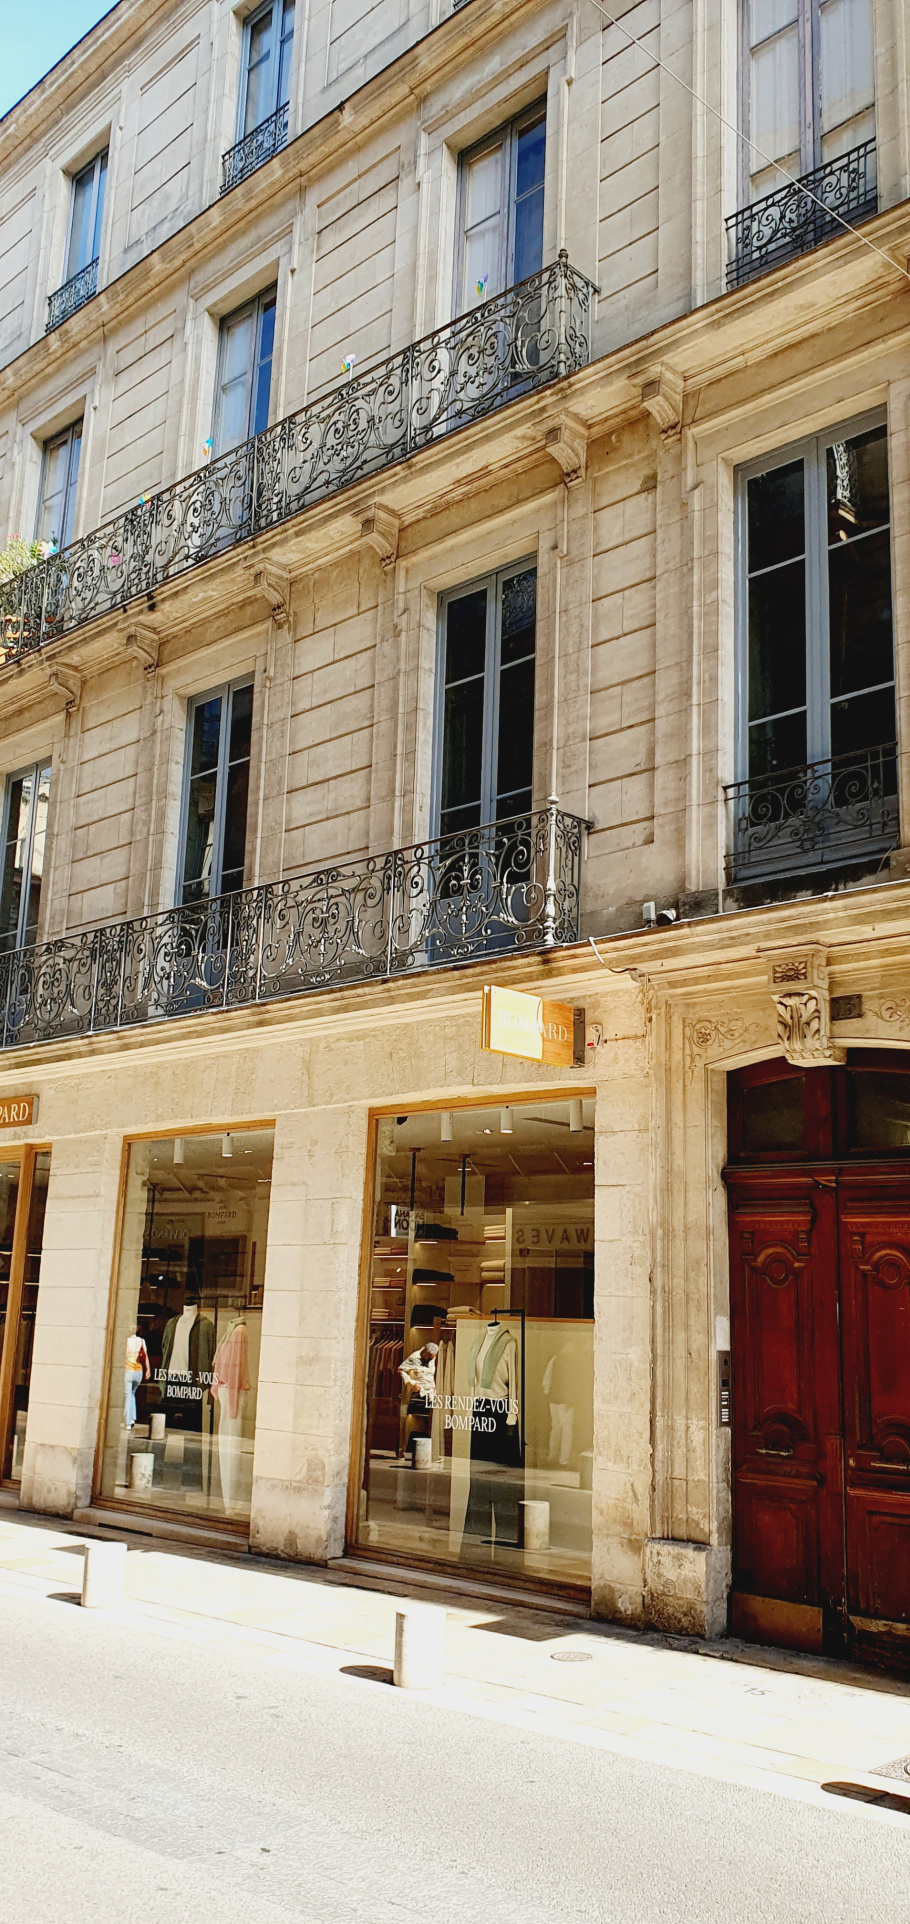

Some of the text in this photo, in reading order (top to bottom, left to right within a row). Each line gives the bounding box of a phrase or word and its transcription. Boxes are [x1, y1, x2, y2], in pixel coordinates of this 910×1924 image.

[497, 1010, 568, 1041] BOMPARD
[154, 1368, 167, 1382] LES
[166, 1385, 203, 1400] BOMPARD
[425, 1394, 519, 1414] LES RENDEZ-VOUS
[444, 1414, 497, 1432] BOMPARD
